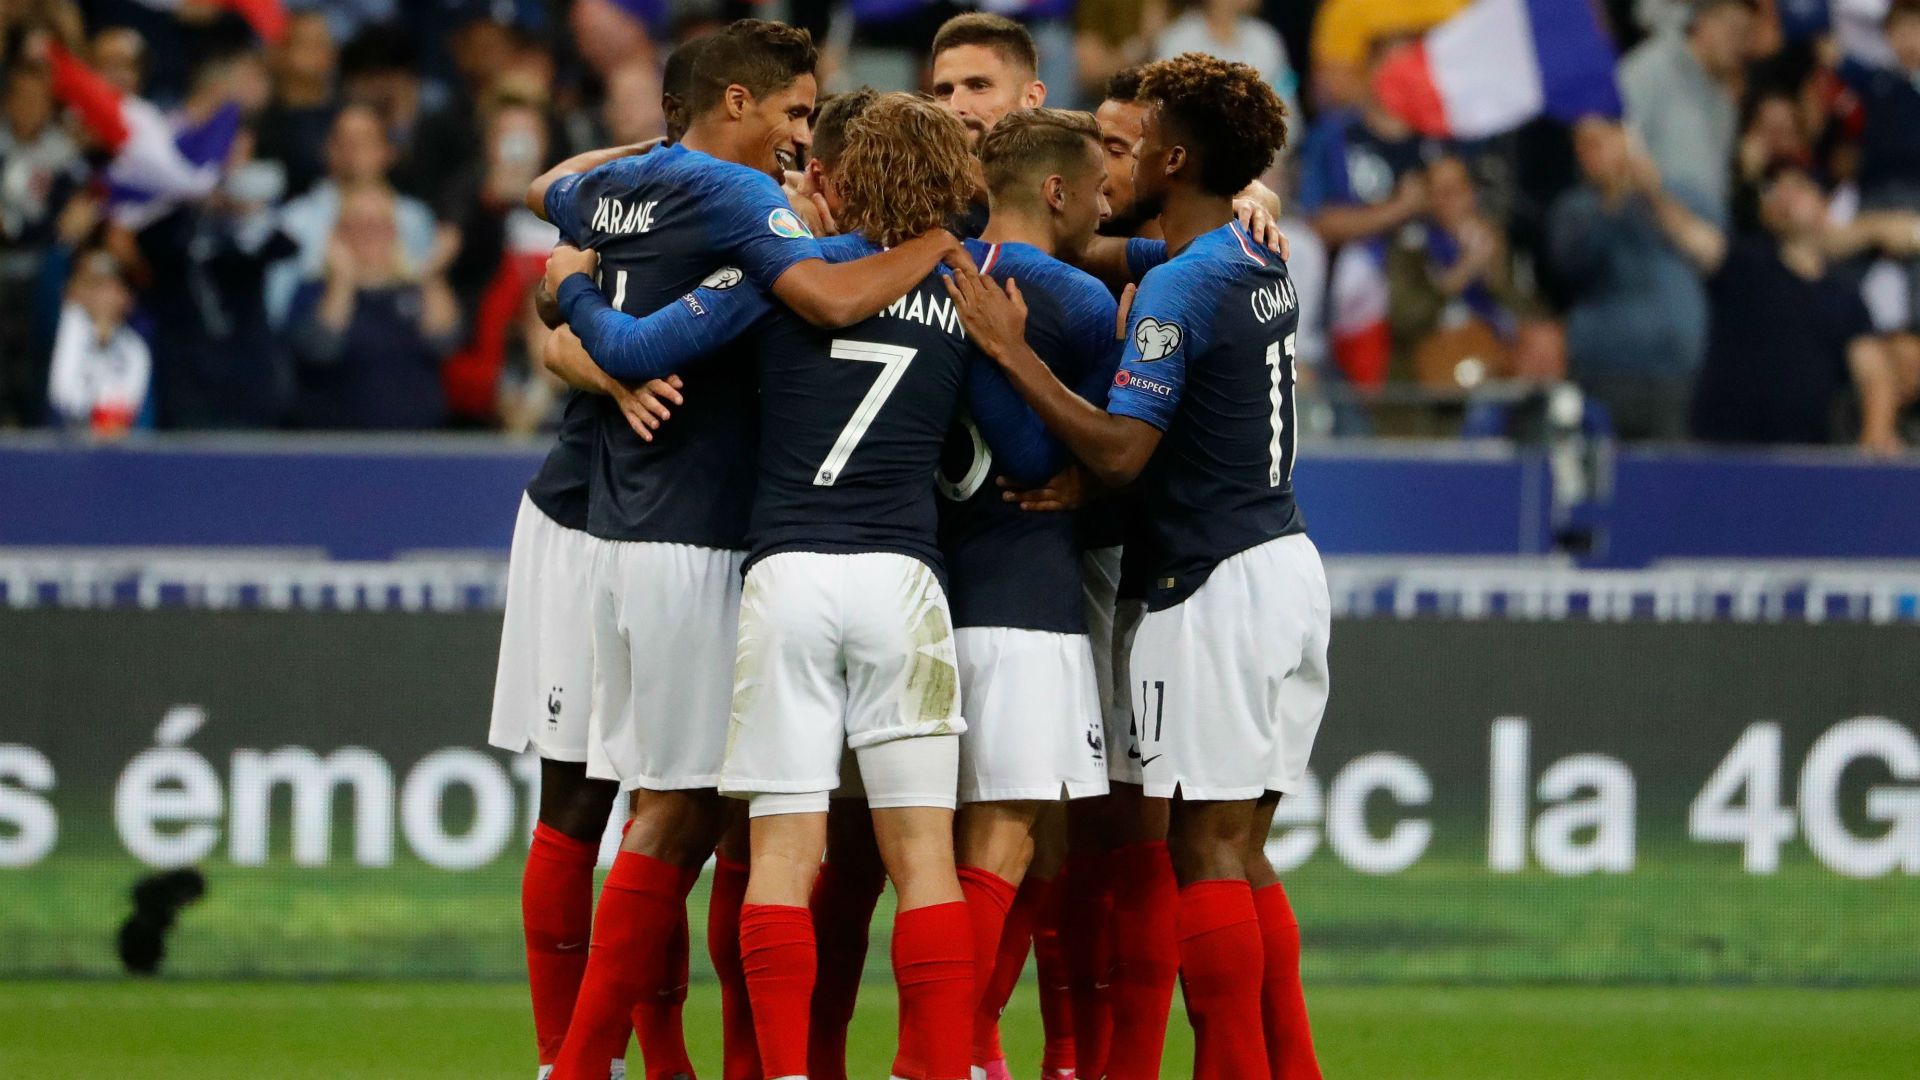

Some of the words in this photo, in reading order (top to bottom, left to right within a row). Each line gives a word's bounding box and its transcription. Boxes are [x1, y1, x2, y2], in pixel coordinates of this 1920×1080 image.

[591, 197, 659, 234] VARANE
[813, 339, 918, 486] 7
[1130, 376, 1172, 396] RESPECT
[1141, 680, 1164, 742] 11
[1489, 716, 1638, 875] la
[1689, 716, 1920, 877] 4G
